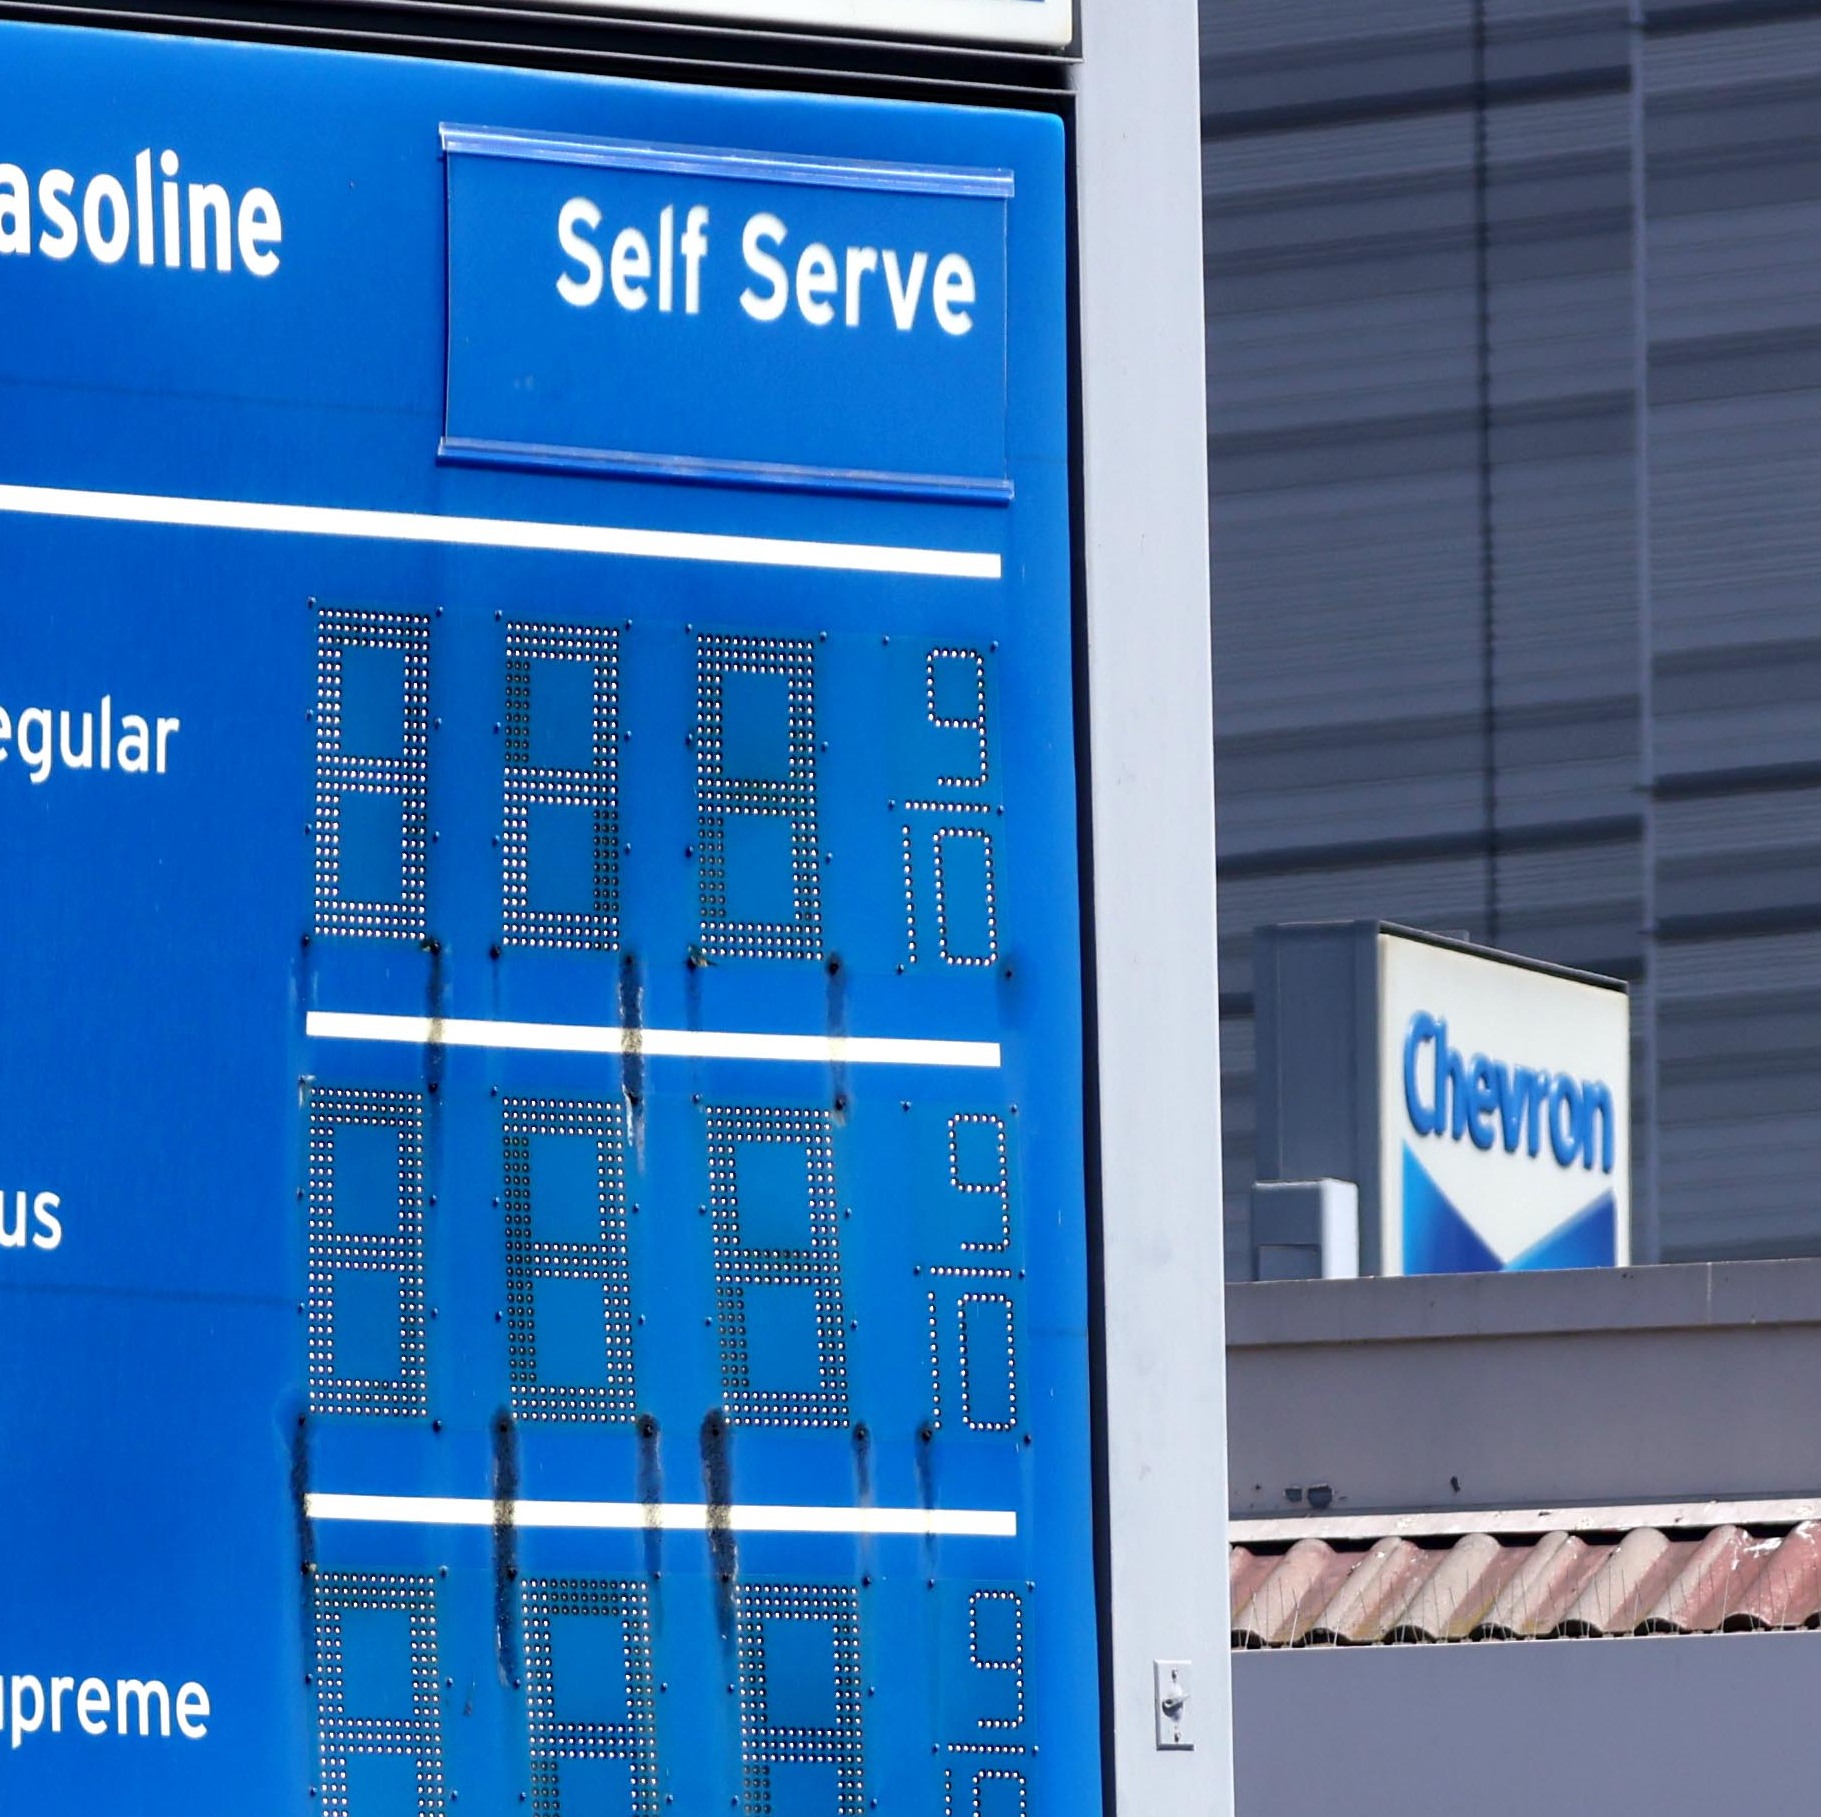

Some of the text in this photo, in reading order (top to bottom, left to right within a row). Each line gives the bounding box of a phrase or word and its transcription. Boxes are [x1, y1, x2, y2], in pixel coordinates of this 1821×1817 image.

[556, 197, 977, 336] Self Serve
[1403, 1009, 1615, 1176] Chevron
[0, 1674, 211, 1750] preme
